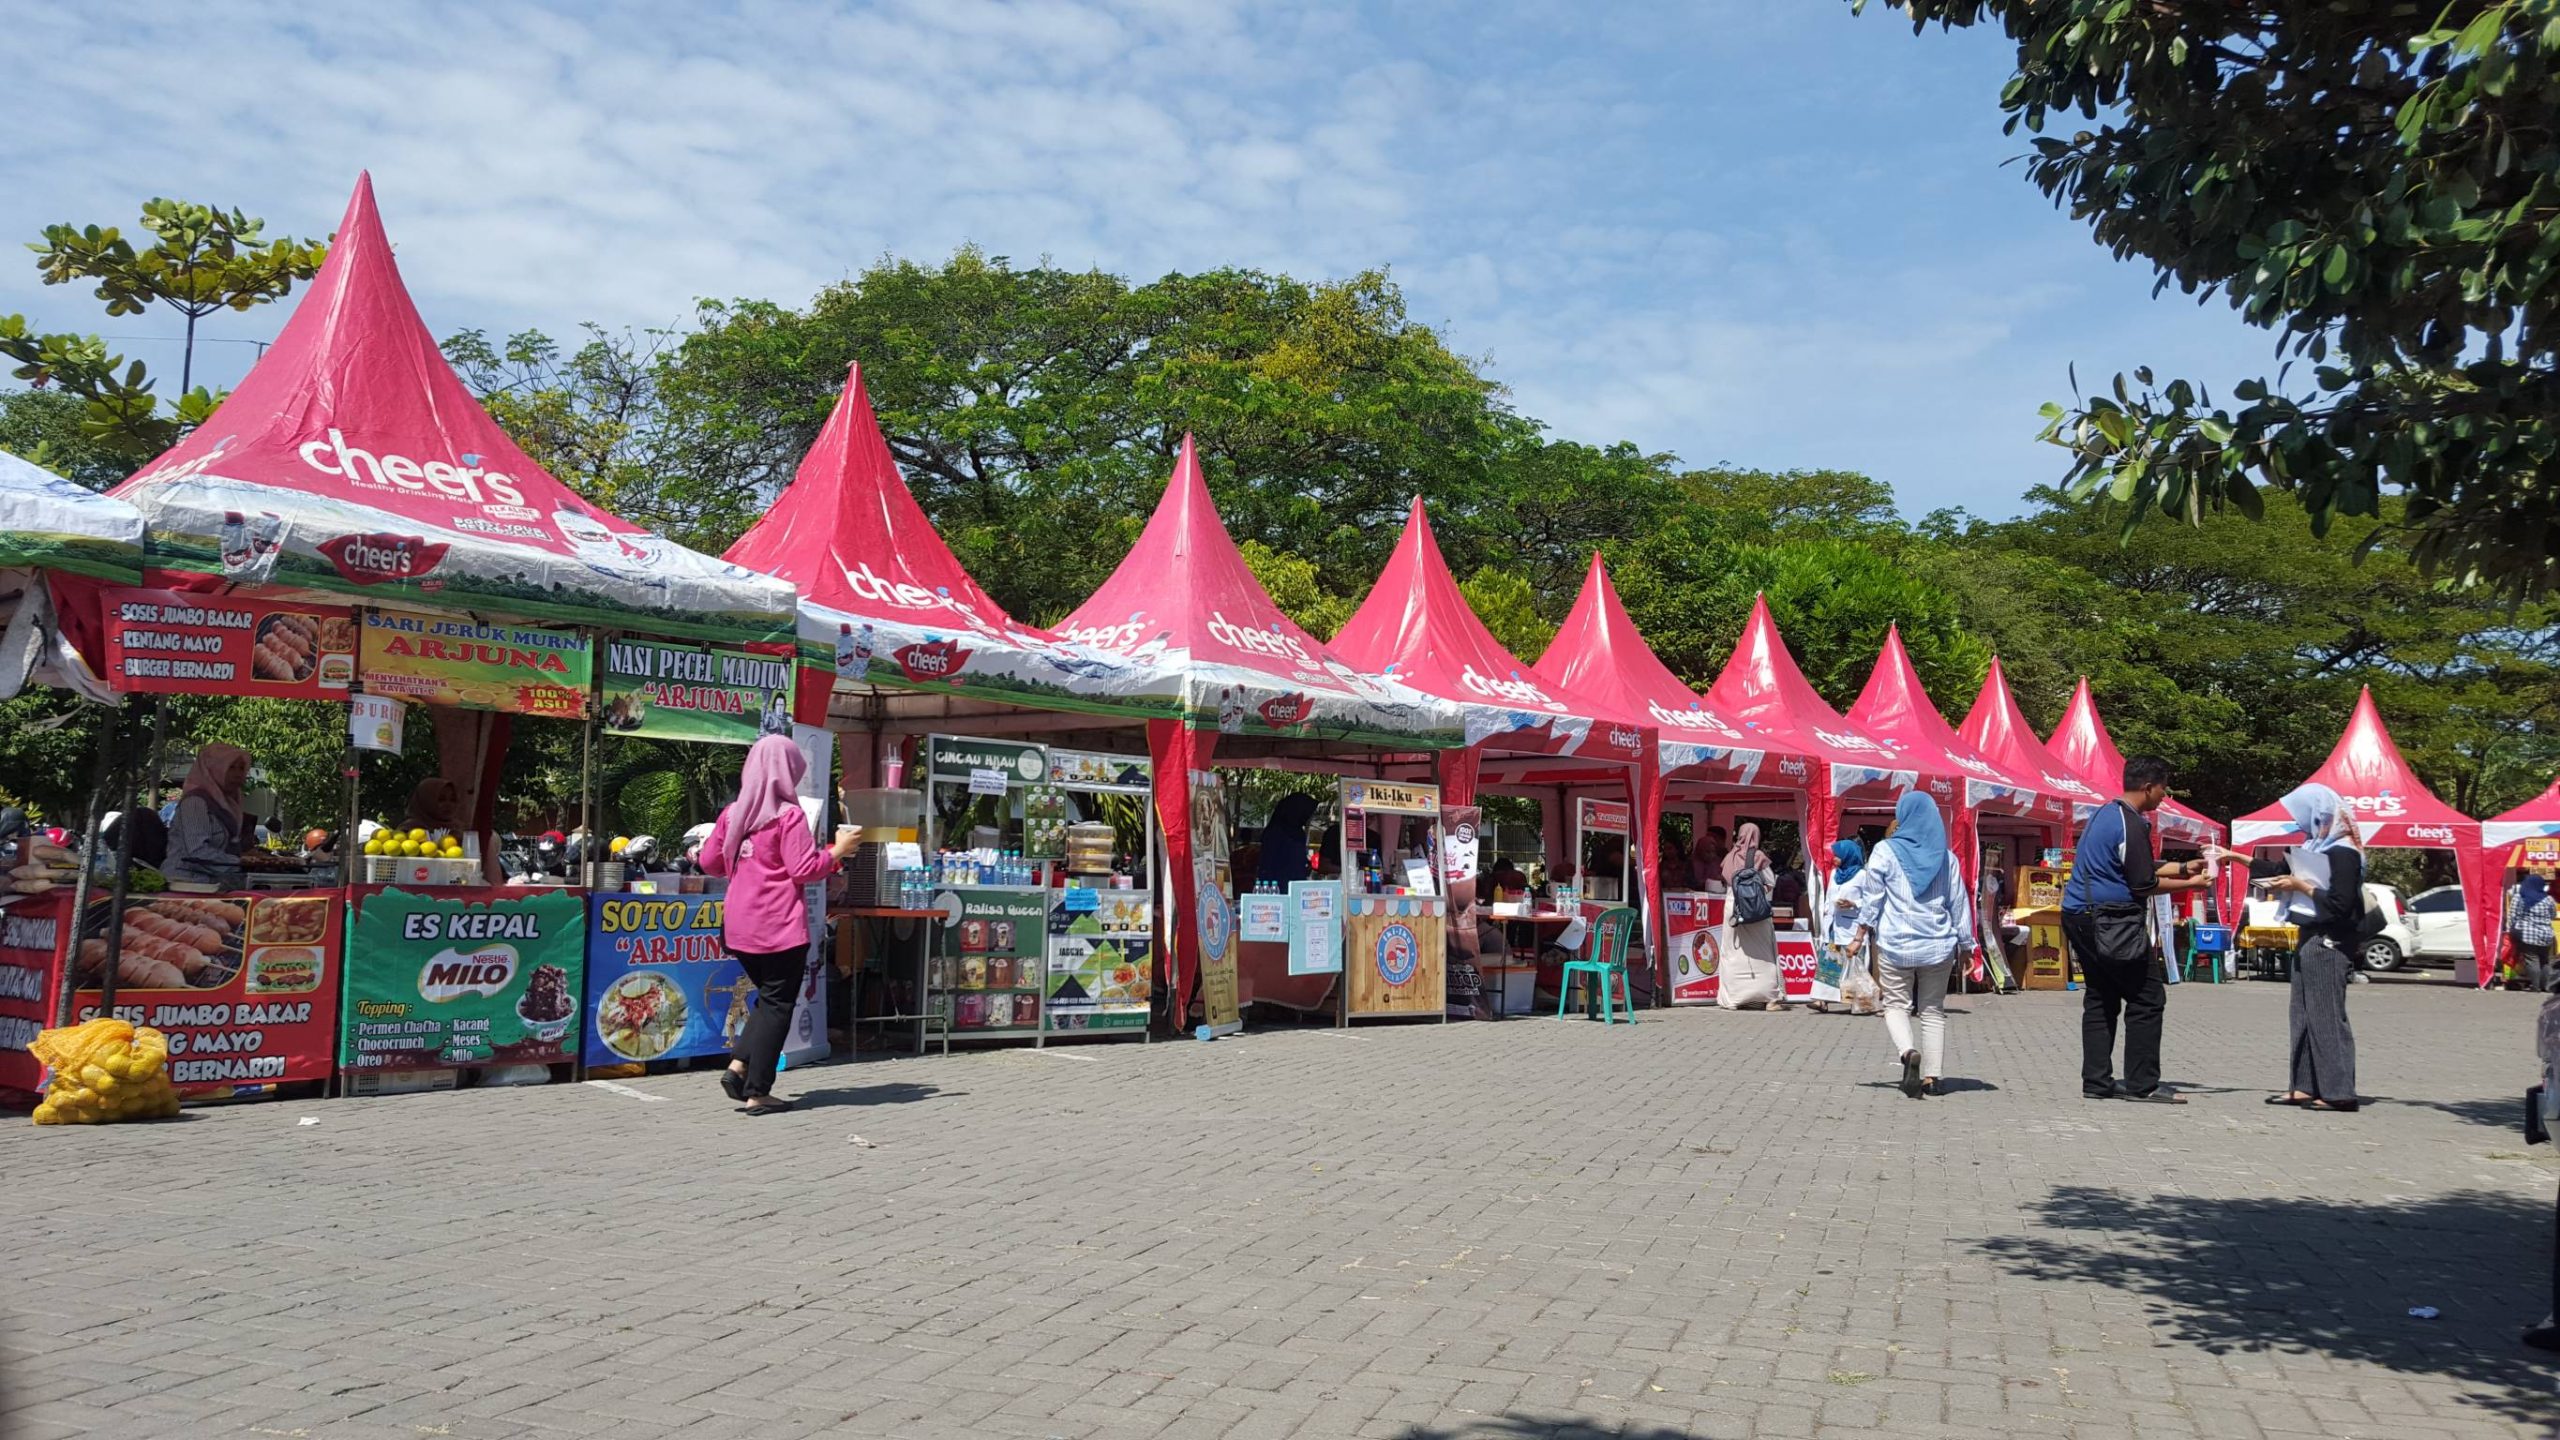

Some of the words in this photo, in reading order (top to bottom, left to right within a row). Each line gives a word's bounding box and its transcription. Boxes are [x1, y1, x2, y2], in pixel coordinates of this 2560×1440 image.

[300, 429, 525, 506] cheers
[351, 479, 395, 493] Healthy
[397, 487, 445, 500] Drinking
[345, 536, 412, 573] cheers
[120, 602, 158, 622] SOSIS
[160, 605, 204, 627] JUMBO
[207, 610, 253, 629] BAKAR
[123, 631, 180, 650] KENTANG
[183, 634, 222, 653] MAYO
[367, 614, 424, 633] SARI
[430, 621, 507, 642] JERUK
[513, 631, 588, 651] MURNI
[1207, 611, 1310, 660] cheers
[383, 635, 572, 673] ARJUNA
[907, 645, 948, 673] cheers
[125, 658, 170, 677] BURGER
[173, 660, 235, 680] BERNARDI
[609, 643, 653, 676] NASI
[658, 648, 715, 683] PECEL
[721, 656, 791, 690] MADIUN
[365, 673, 438, 687] MENYEHATKAN
[380, 684, 406, 693] KAYA
[408, 686, 435, 695] VIT-C
[1462, 664, 1552, 702] cheers
[528, 688, 572, 700] 100%
[533, 699, 569, 710] ASLI
[1268, 702, 1298, 720] cheers
[1648, 698, 1728, 730] cheers
[1609, 724, 1641, 748] cheers
[1779, 755, 1806, 775] cheers
[2407, 824, 2453, 839] cheers
[2527, 851, 2558, 860] POCI
[601, 900, 688, 932] SOTO
[1696, 902, 1708, 921] 20
[404, 913, 442, 939] ES
[447, 913, 540, 939] KEPAL
[426, 963, 508, 986] MILO
[150, 1004, 231, 1027] JUMBO
[234, 1002, 313, 1025] BAKAR
[357, 1001, 405, 1017] Topping
[358, 1021, 402, 1036] Permen
[404, 1019, 441, 1033] ChaCha
[453, 1018, 490, 1032] Kacang
[192, 1031, 263, 1055] MAYO
[358, 1036, 424, 1051] Chococrunch
[451, 1033, 481, 1047] Meses
[356, 1053, 383, 1067] Oreo
[451, 1049, 473, 1062] Milo
[173, 1056, 286, 1083] BERNARDI
